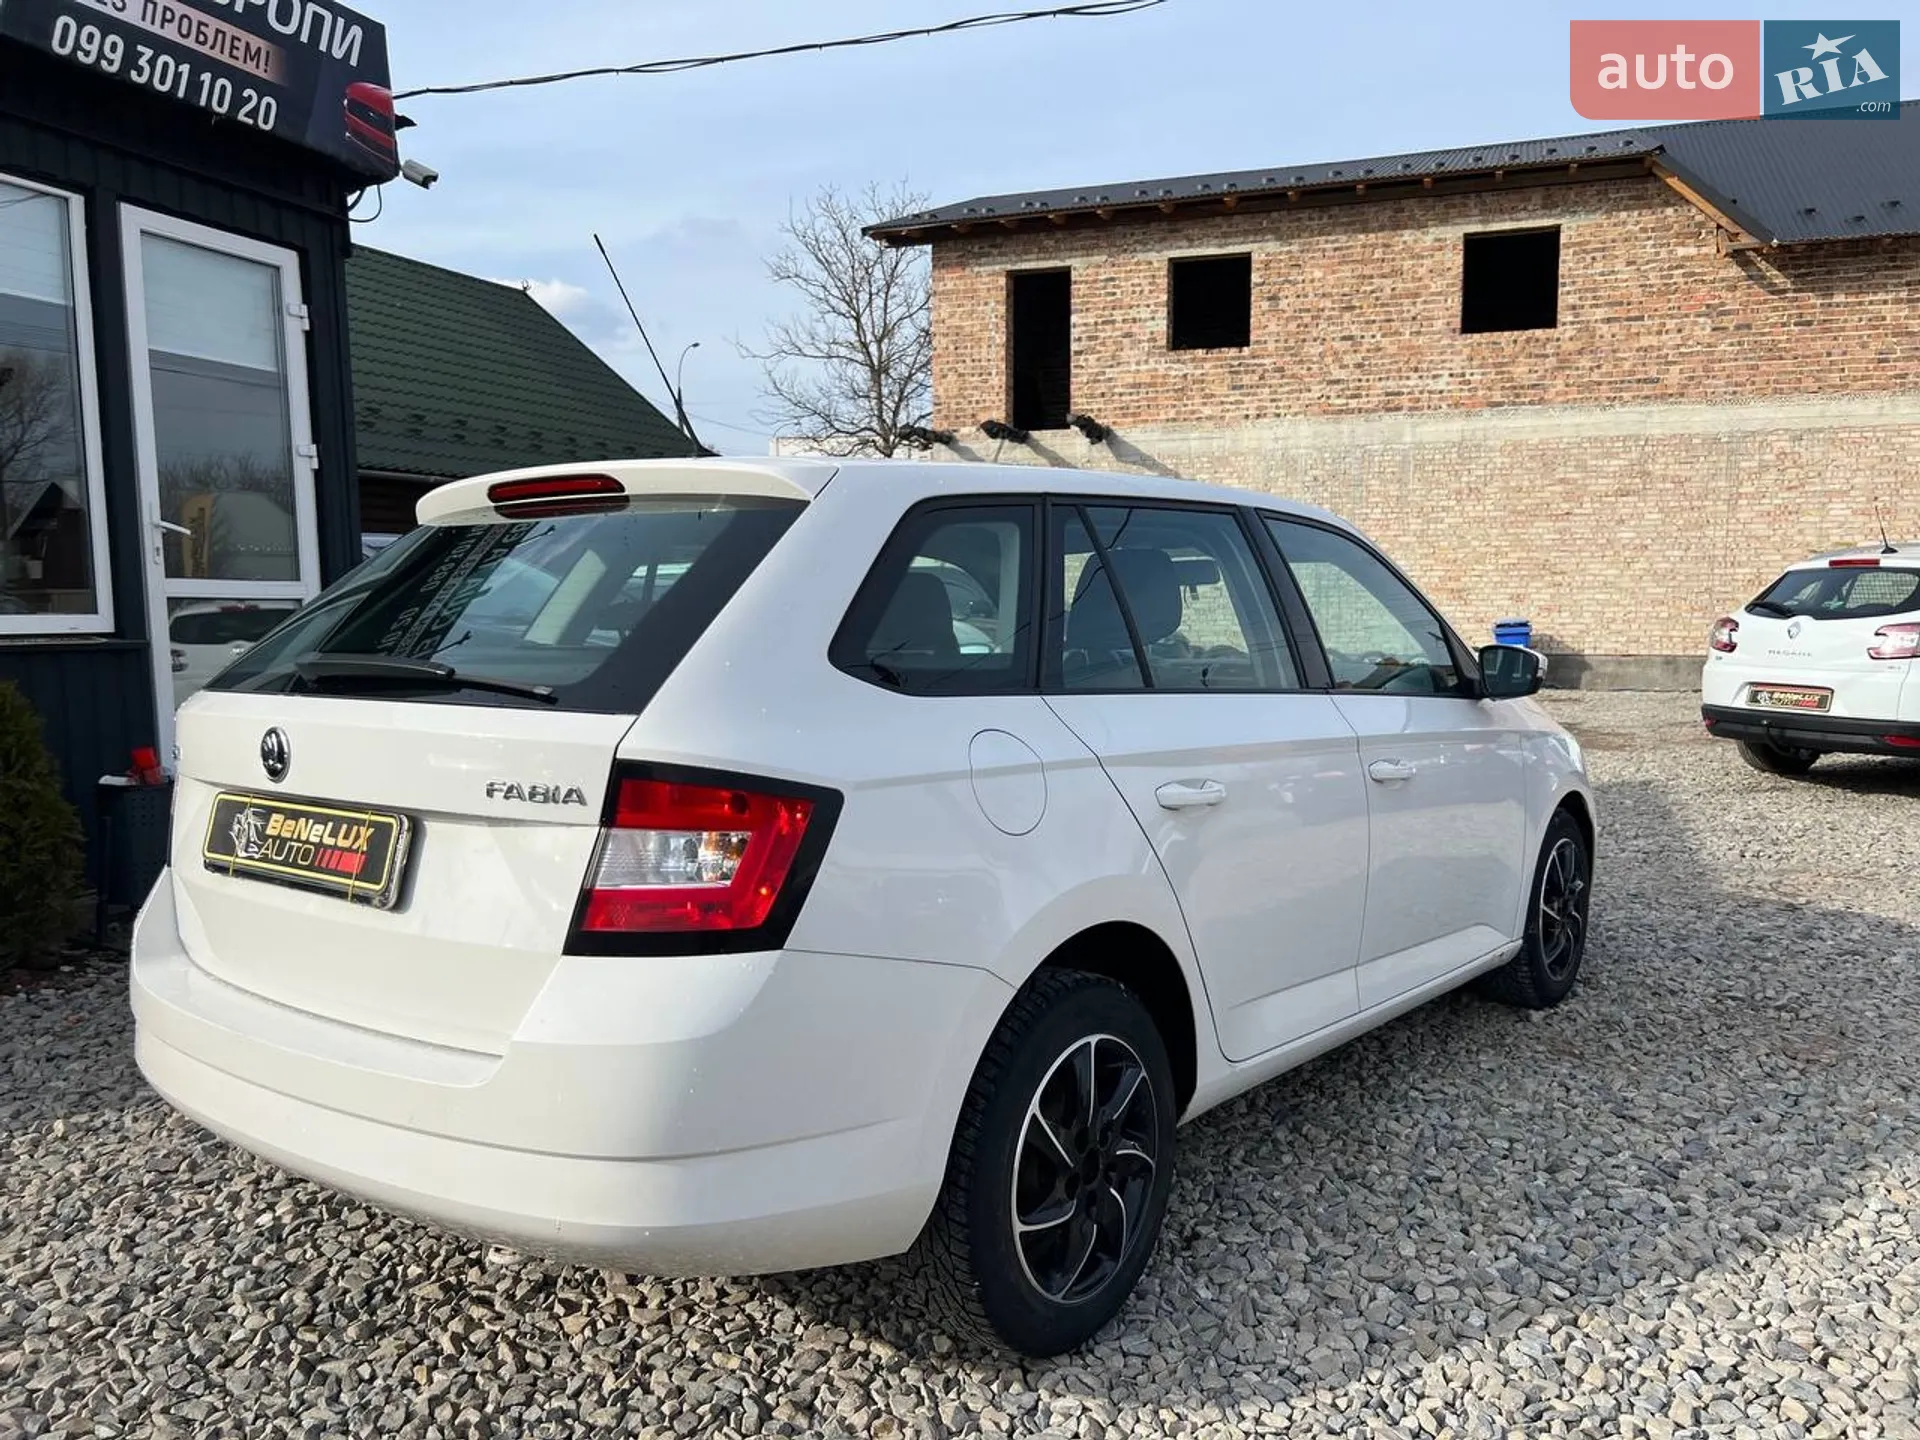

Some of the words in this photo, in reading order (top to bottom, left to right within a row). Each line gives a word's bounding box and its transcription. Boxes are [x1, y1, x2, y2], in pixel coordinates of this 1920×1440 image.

[141, 0, 270, 73] ПРОБЛЕМ!
[52, 15, 124, 73] 099
[130, 45, 190, 98] 301
[199, 72, 232, 114] 10
[237, 89, 277, 131] 20
[486, 782, 588, 806] FABIA
[258, 839, 315, 866] AUTO
